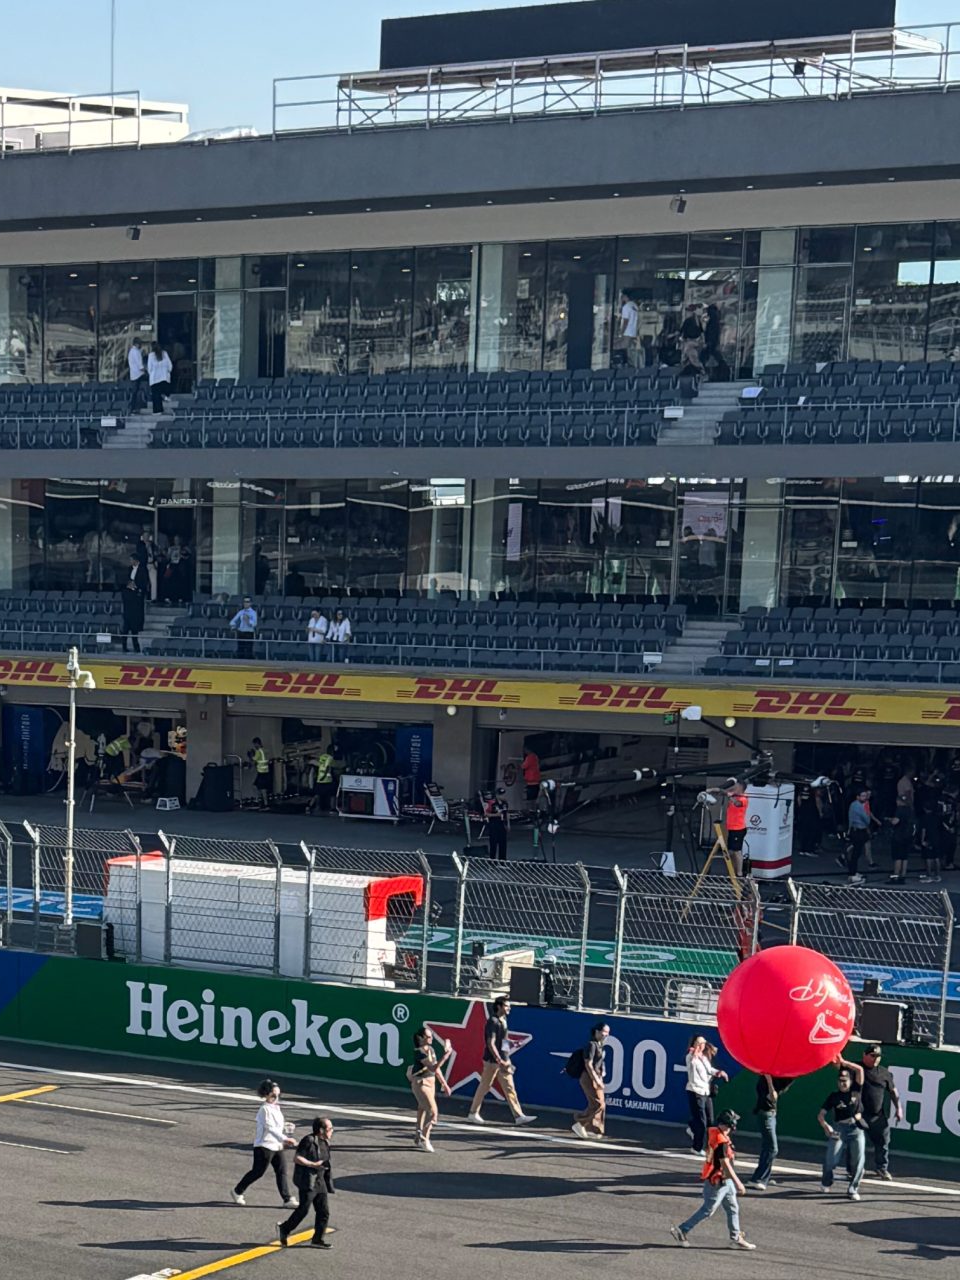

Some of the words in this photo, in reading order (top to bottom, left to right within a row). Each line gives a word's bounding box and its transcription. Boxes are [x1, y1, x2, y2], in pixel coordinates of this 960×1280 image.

[119, 665, 197, 689] DHL
[262, 671, 345, 696] DHL
[414, 678, 503, 702] DHL
[576, 684, 675, 709] DHL
[751, 690, 857, 716] DHL
